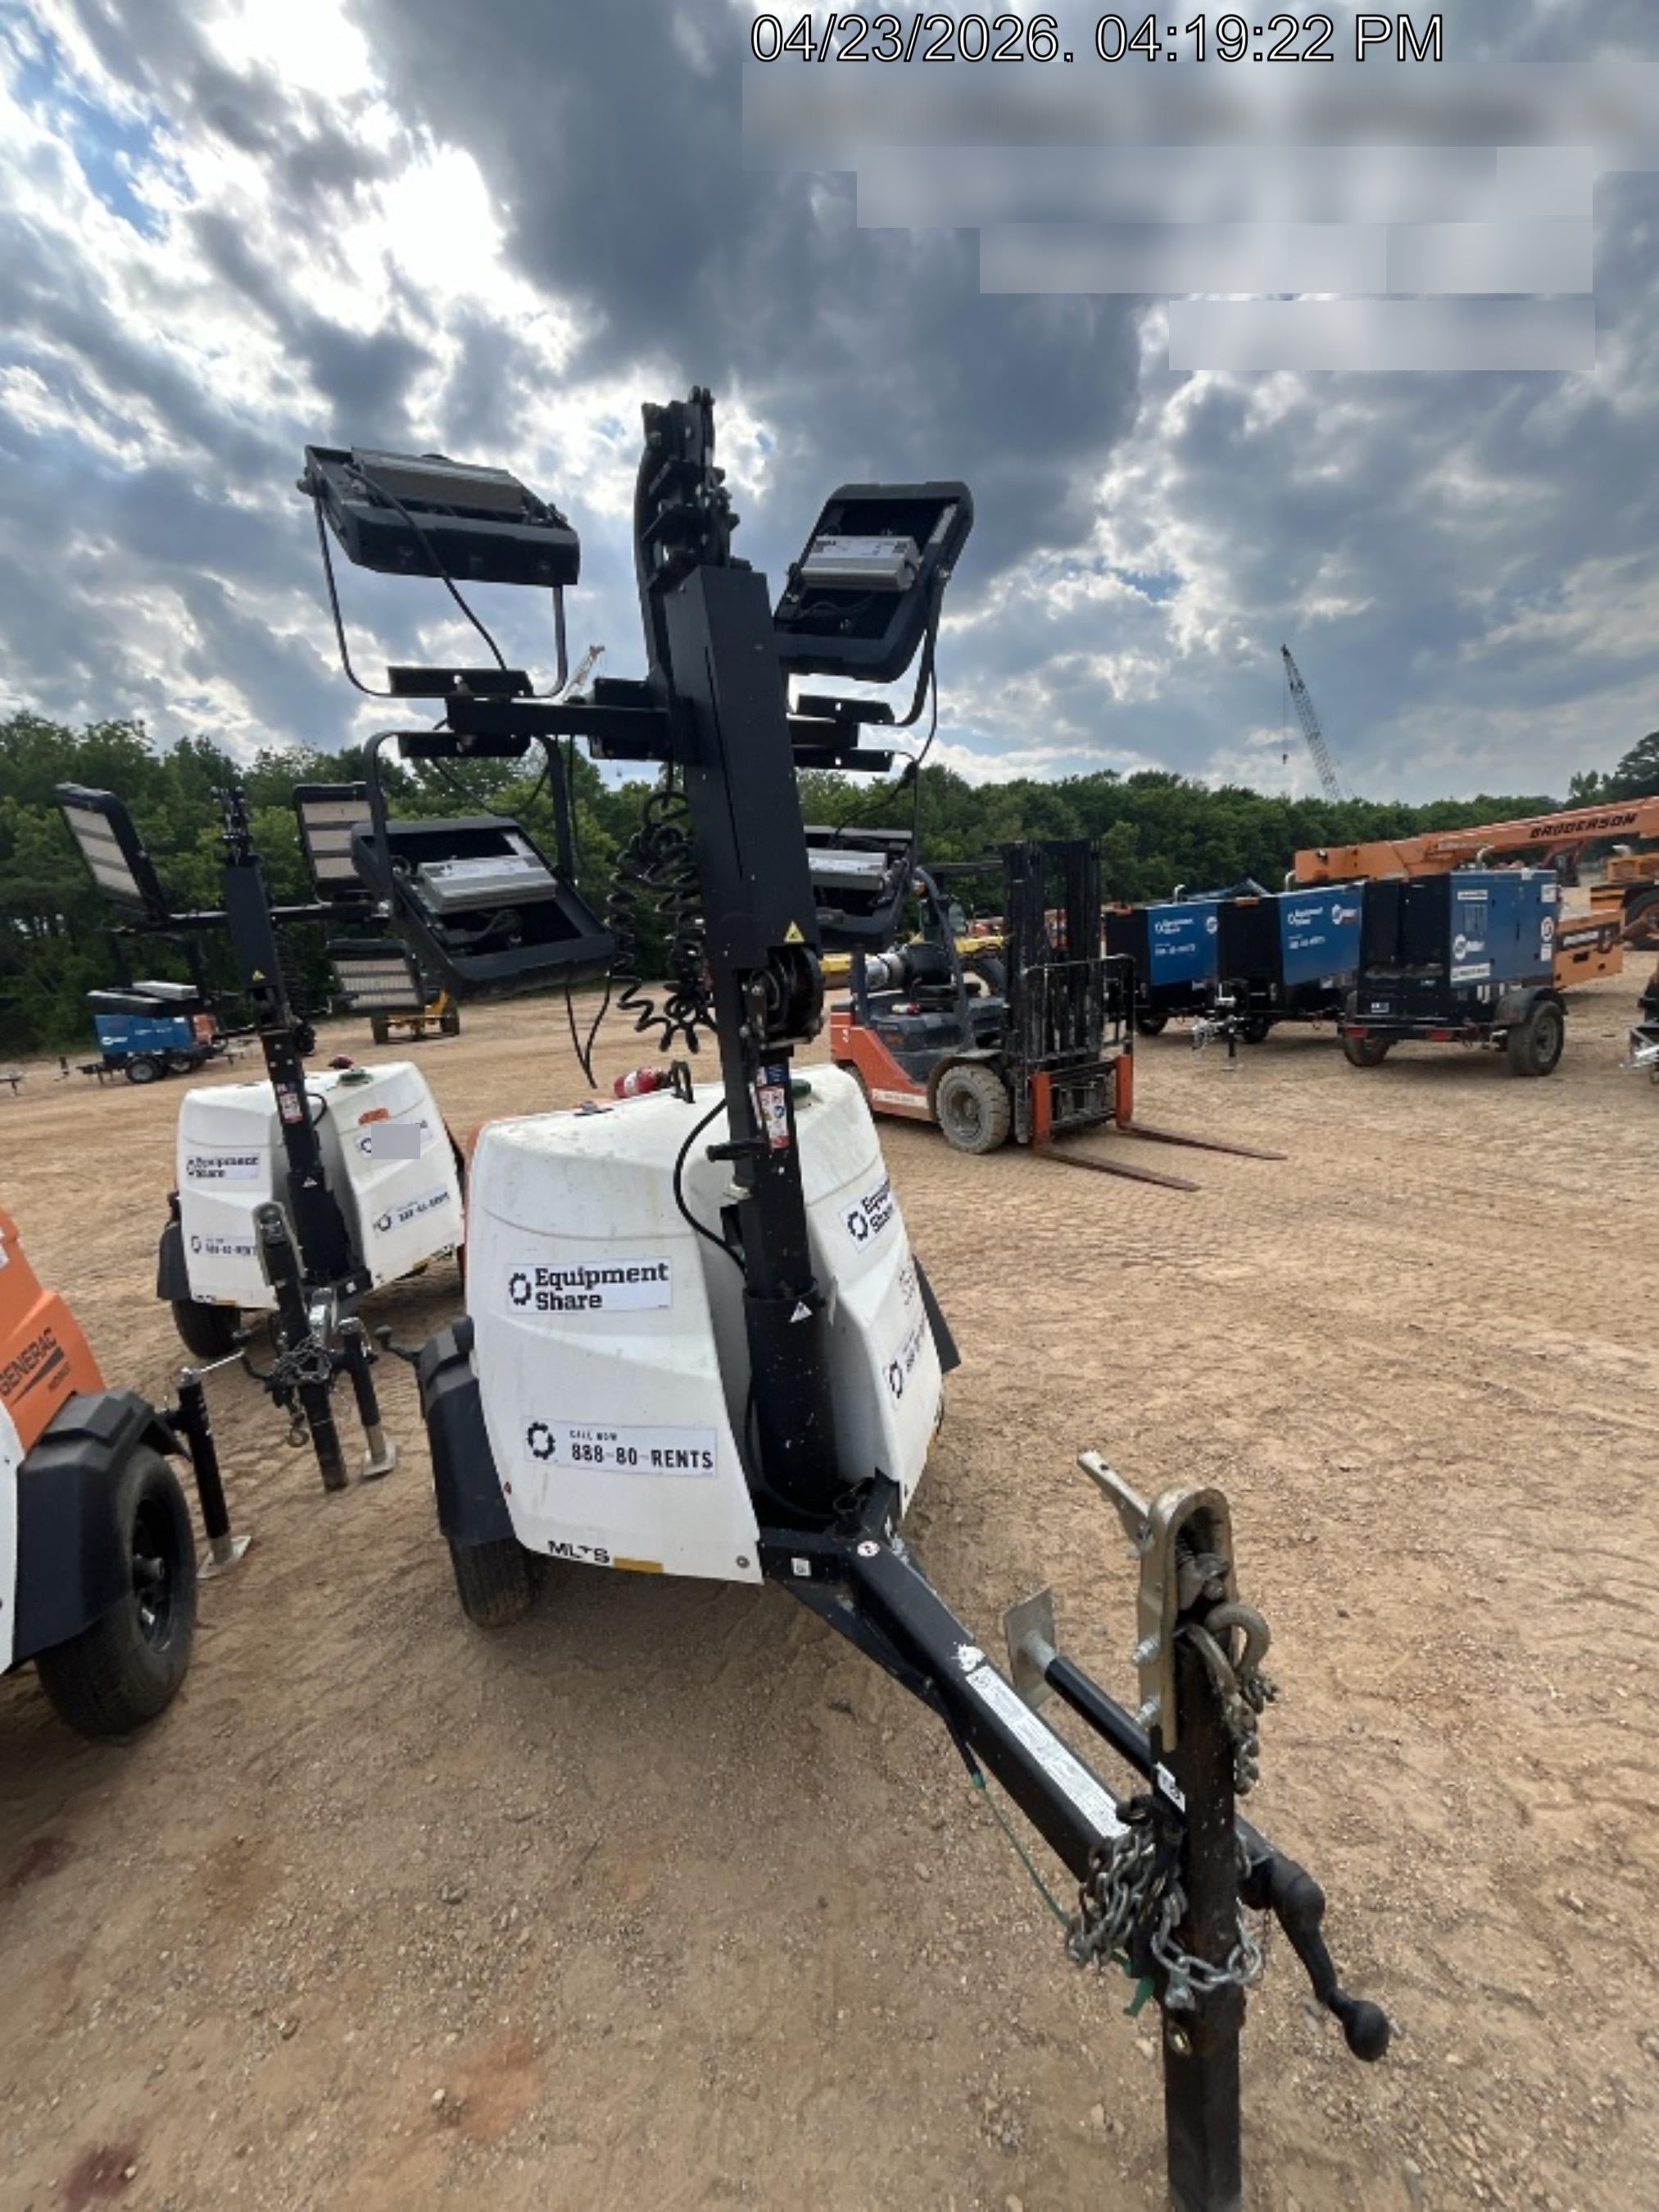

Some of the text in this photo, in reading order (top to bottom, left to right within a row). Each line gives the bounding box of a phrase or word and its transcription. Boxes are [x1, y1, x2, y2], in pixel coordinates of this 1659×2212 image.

[535, 1262, 669, 1290] Equipment
[535, 1291, 603, 1311] Share
[571, 1444, 714, 1469] 888-80-RENTS
